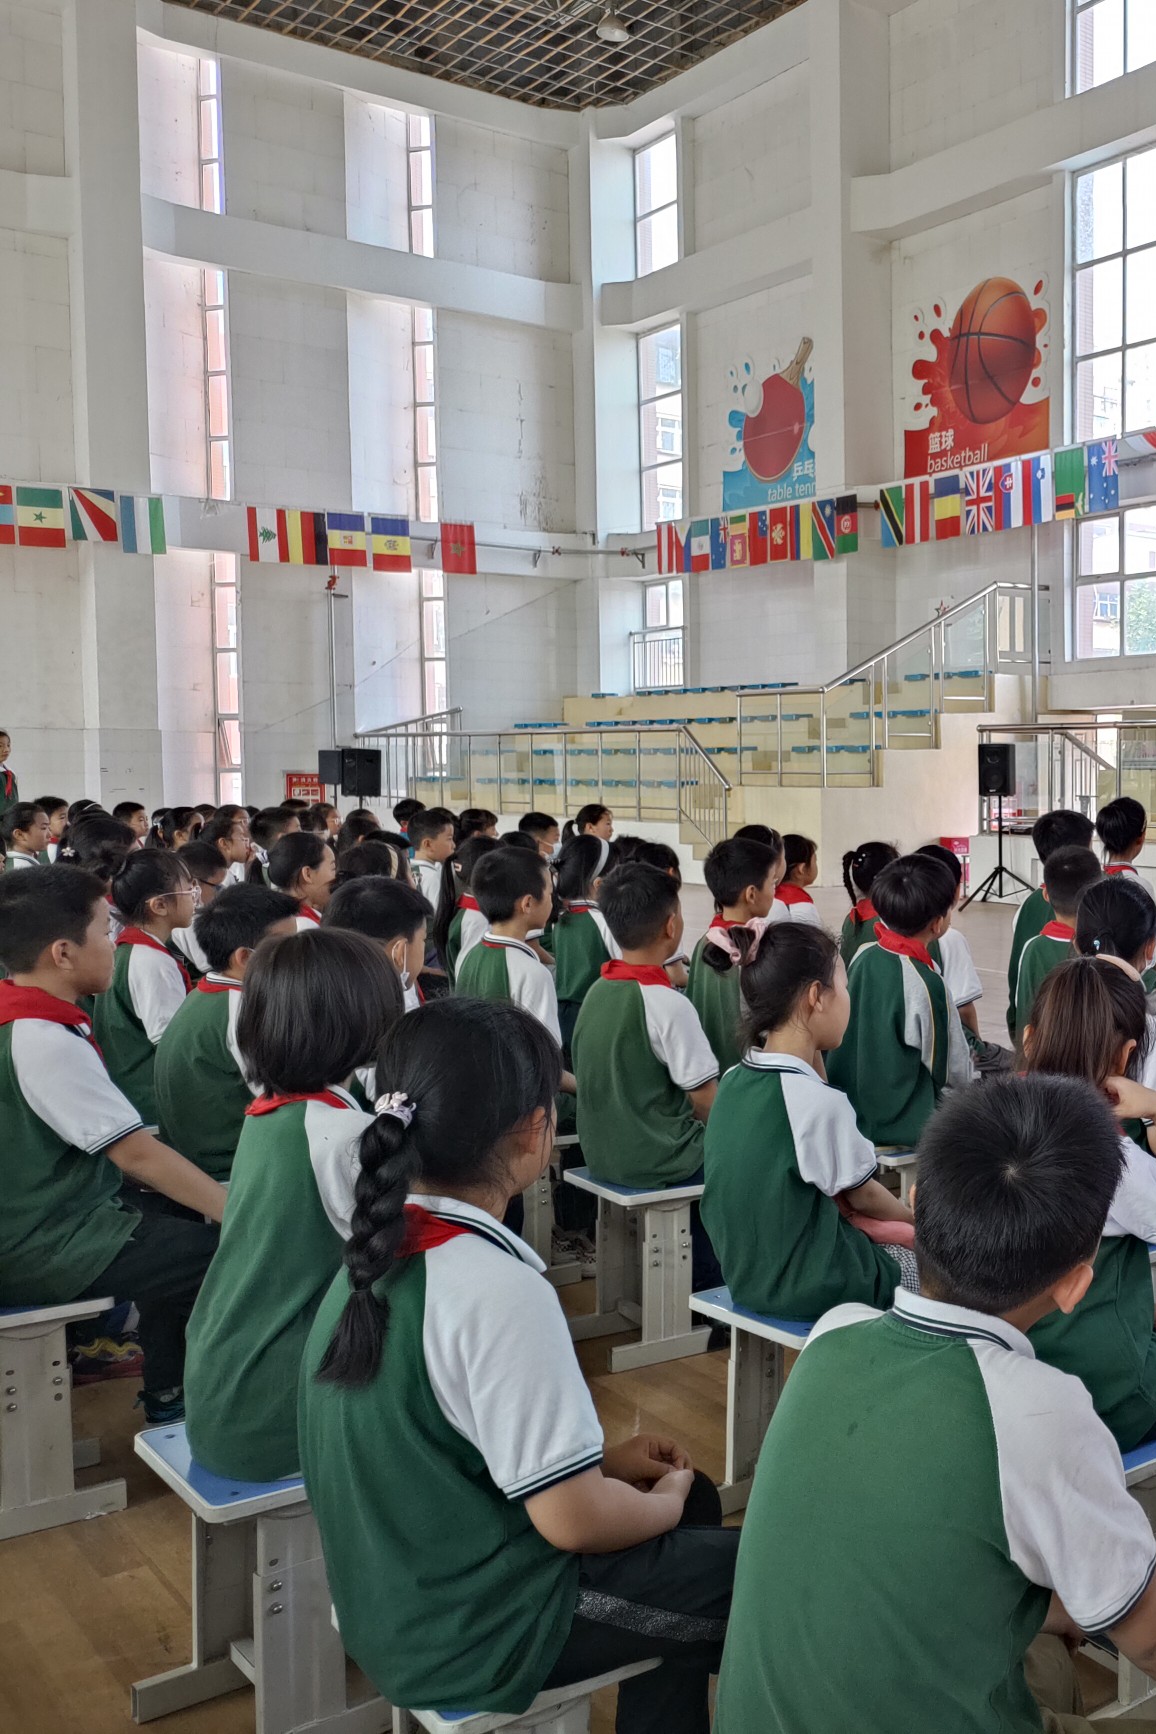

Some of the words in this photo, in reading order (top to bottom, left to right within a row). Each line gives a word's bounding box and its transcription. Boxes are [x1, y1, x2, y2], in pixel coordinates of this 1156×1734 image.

[928, 429, 954, 454] 篮球
[927, 442, 988, 473] basketball
[767, 483, 793, 502] table
